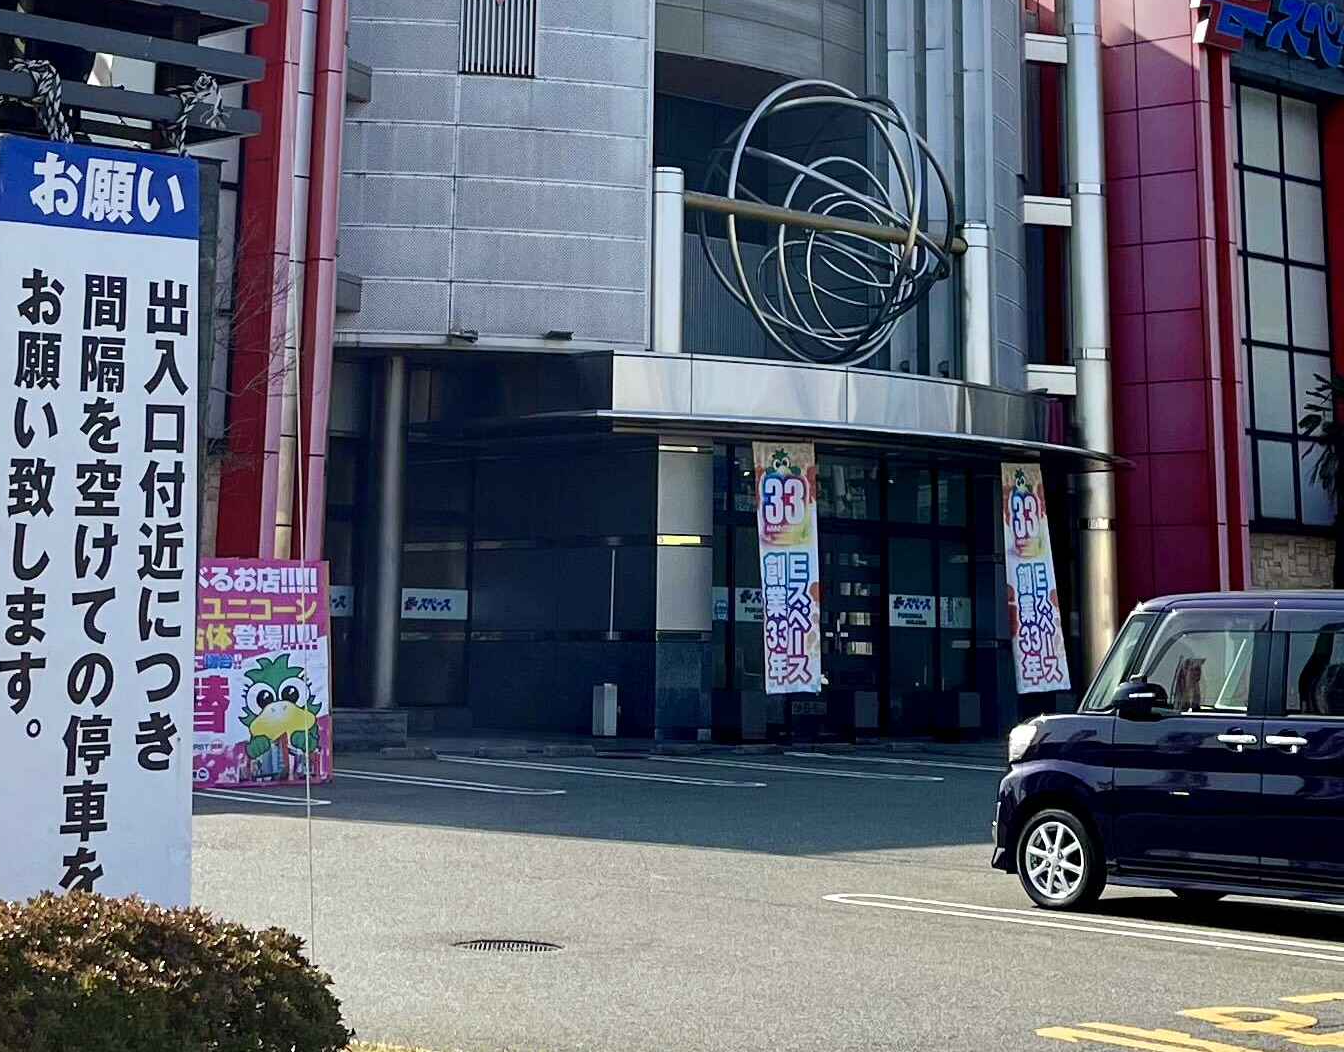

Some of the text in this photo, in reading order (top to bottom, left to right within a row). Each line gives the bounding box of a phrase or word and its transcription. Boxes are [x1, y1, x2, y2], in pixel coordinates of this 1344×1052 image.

[29, 151, 186, 225] お願い
[135, 279, 189, 771] 出入口付近につき
[763, 477, 806, 526] 33
[1012, 495, 1039, 539] 33
[59, 273, 128, 893] 間隔を空けての停車を
[763, 552, 789, 686] 創業33年
[787, 552, 812, 686] Eスペース
